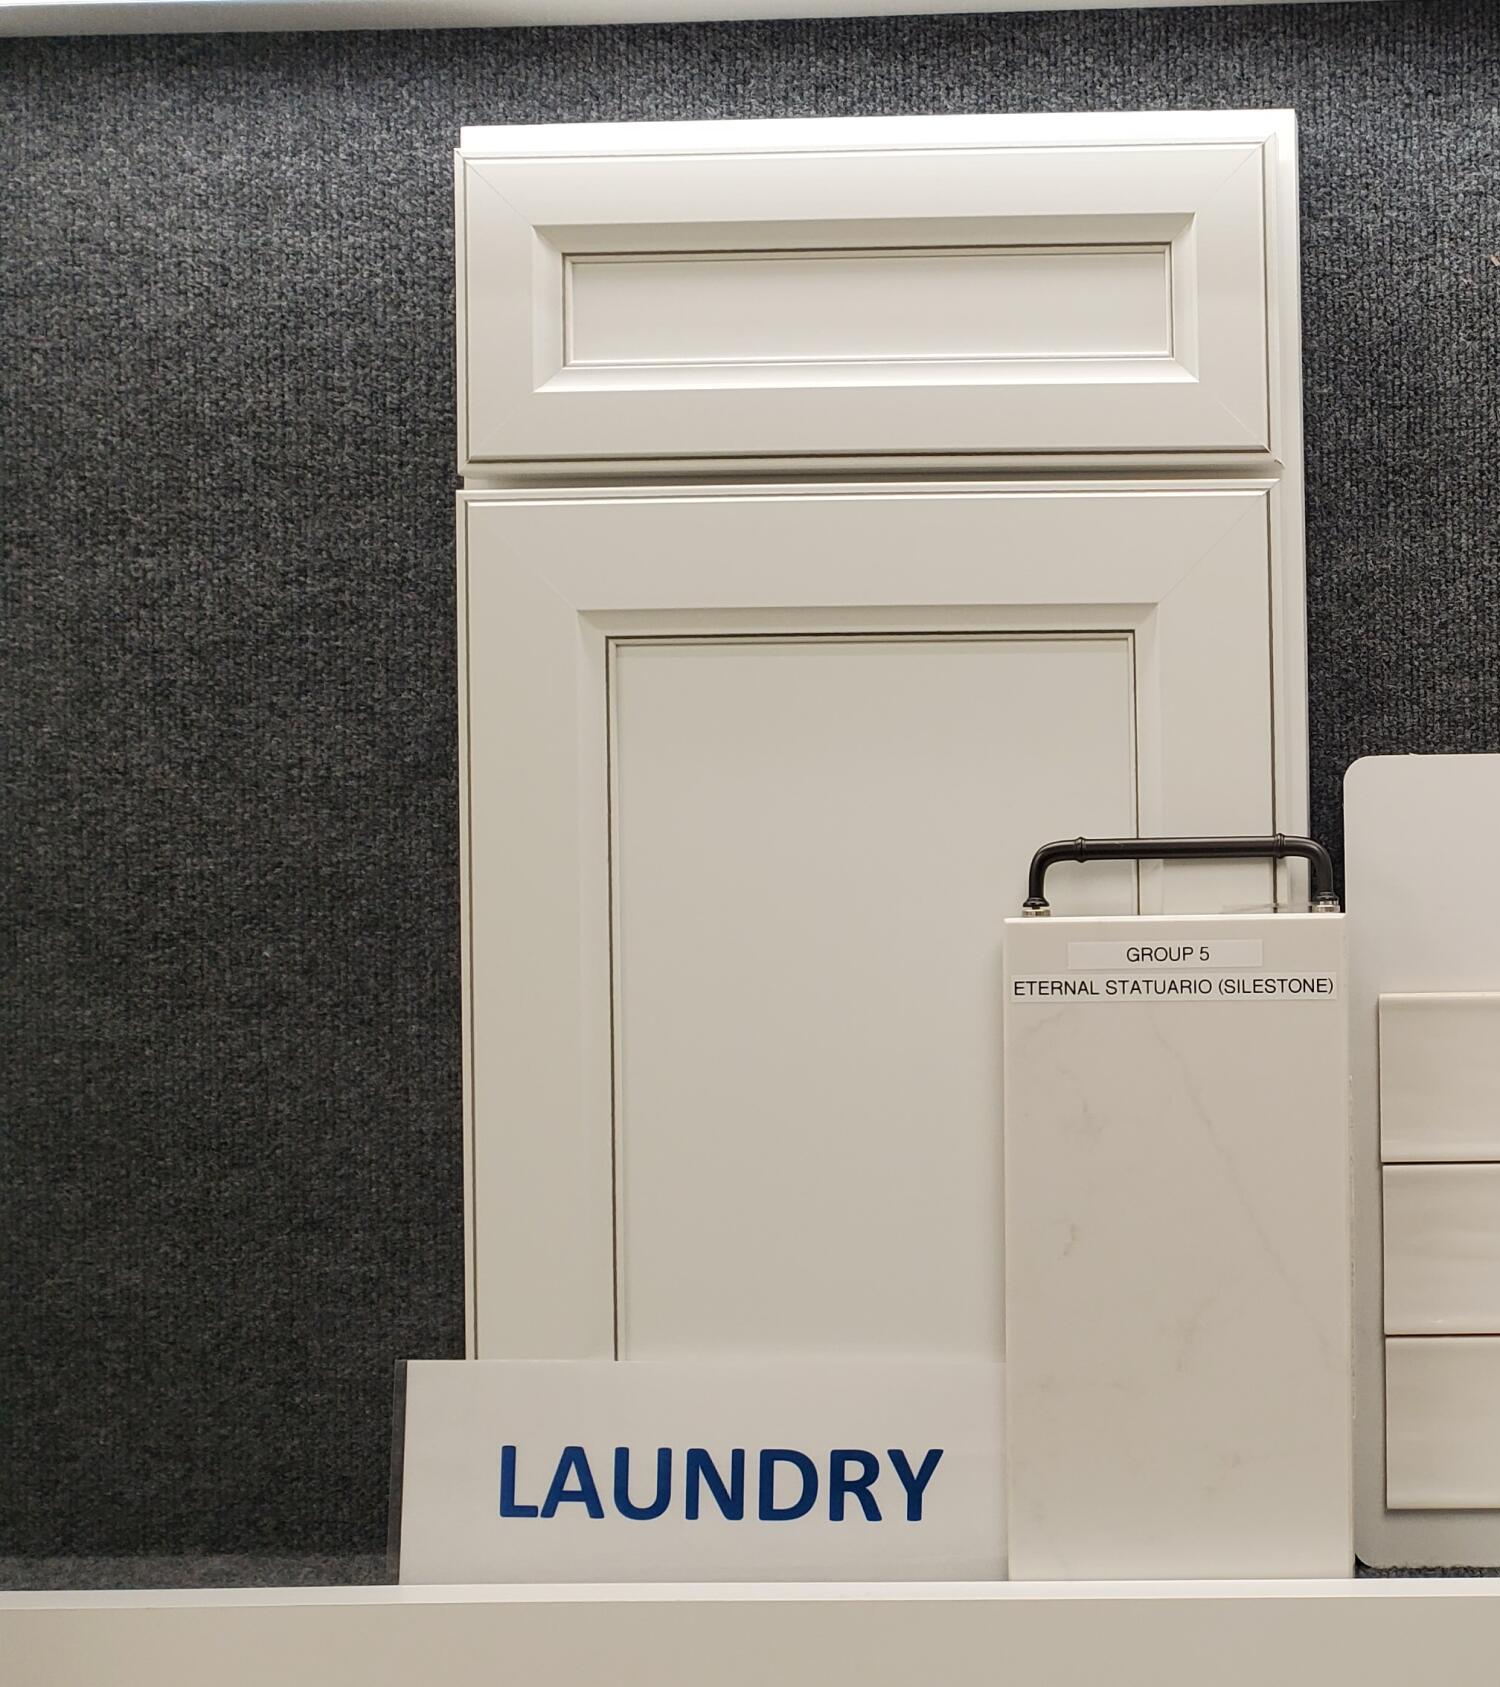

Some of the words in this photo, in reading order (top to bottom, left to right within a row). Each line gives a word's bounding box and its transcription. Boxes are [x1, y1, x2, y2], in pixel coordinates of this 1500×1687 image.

[1126, 947, 1194, 962] GROUP
[1199, 946, 1210, 961] 5
[1013, 980, 1100, 996] ETERNAL
[1105, 979, 1213, 995] STATUARIO
[1218, 977, 1334, 996] (SILESTONE)
[499, 1445, 944, 1522] LAUNDRY
